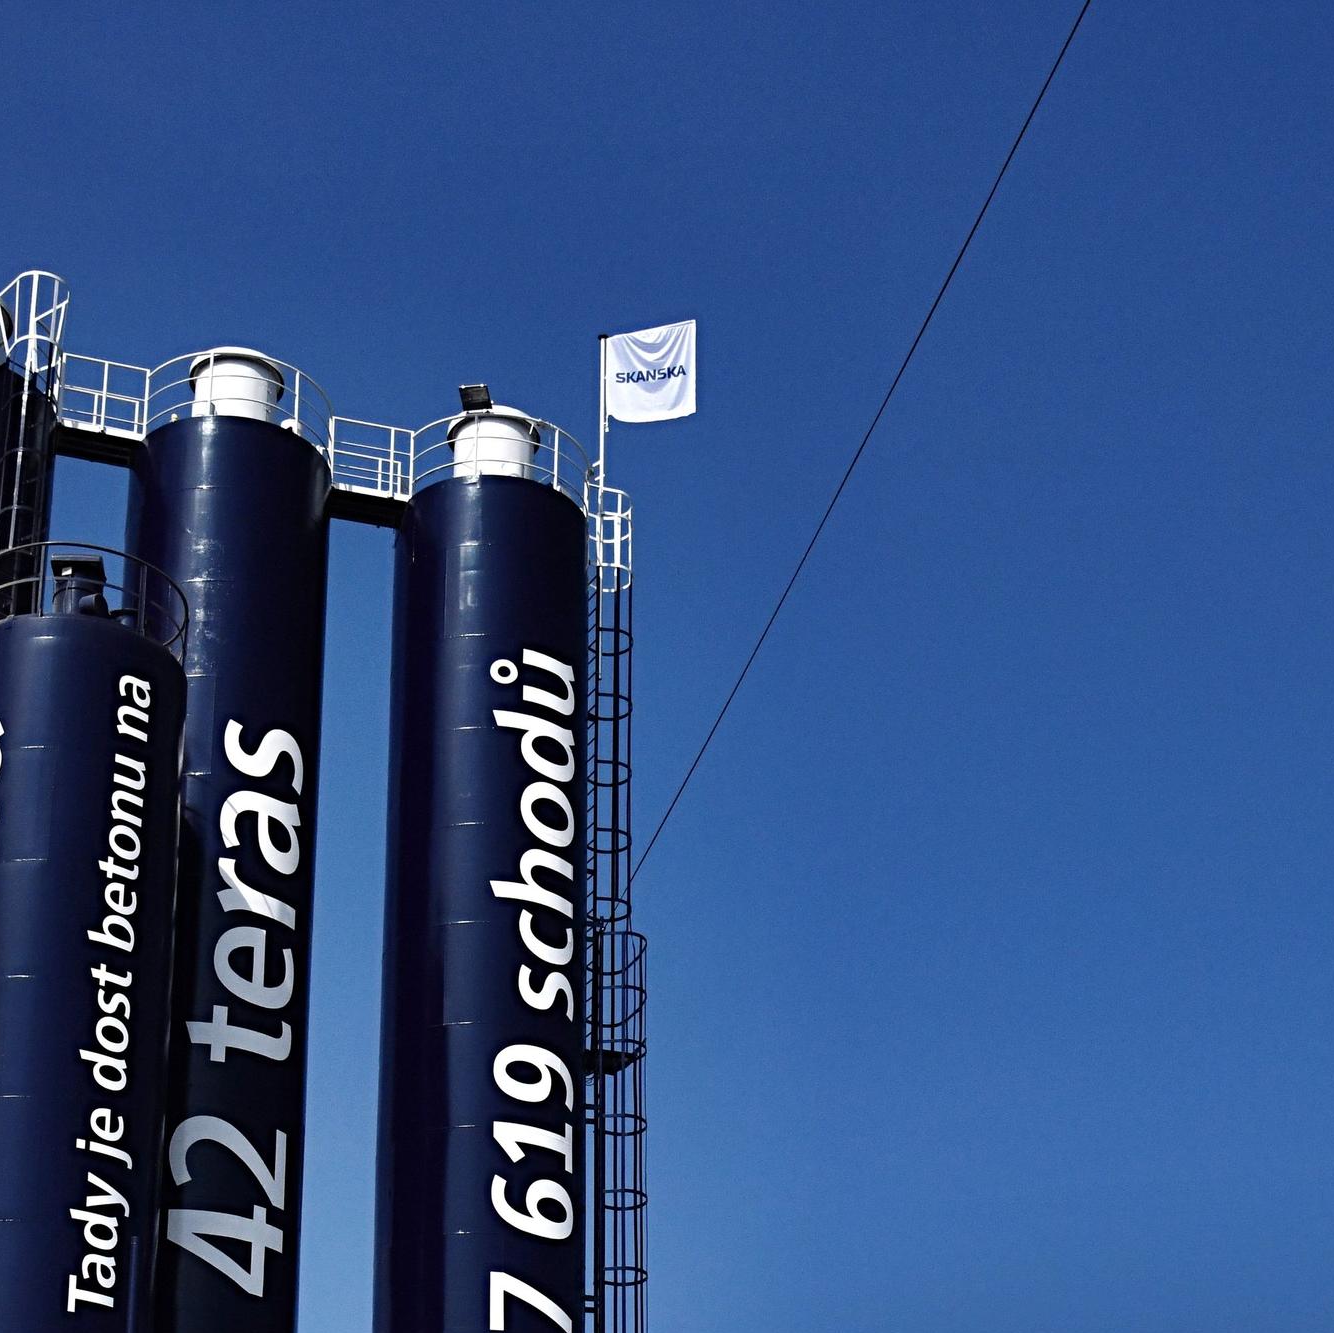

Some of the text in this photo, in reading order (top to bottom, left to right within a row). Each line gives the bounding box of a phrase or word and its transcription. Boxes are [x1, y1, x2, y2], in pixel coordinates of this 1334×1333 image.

[616, 365, 687, 384] SKANSKA
[67, 674, 152, 1313] Tady je dost betonu na
[166, 718, 305, 1298] 42 teras
[489, 647, 576, 1022] schodů
[490, 1043, 574, 1240] 619
